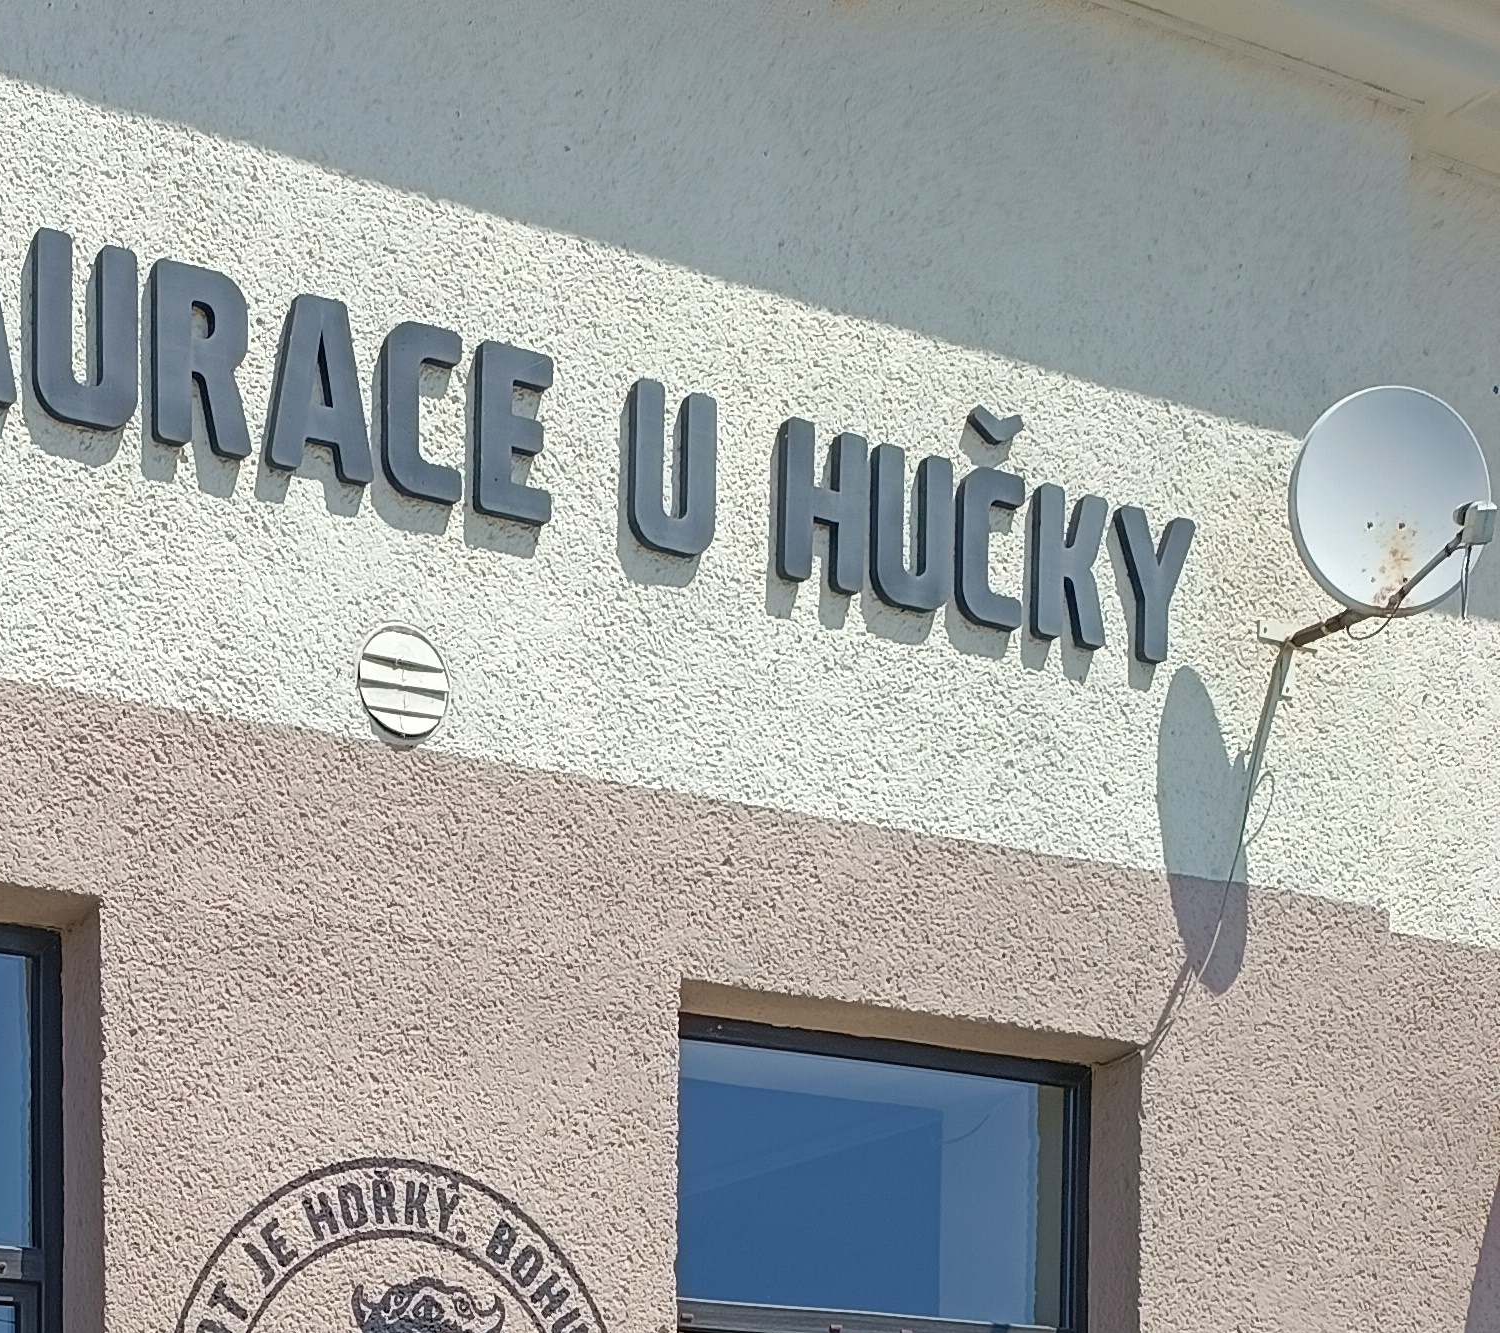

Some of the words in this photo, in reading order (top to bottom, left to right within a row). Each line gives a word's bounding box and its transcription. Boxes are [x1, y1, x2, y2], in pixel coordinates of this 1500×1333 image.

[626, 379, 717, 558] U
[775, 404, 1195, 664] HUČKY
[242, 1217, 298, 1287] JE
